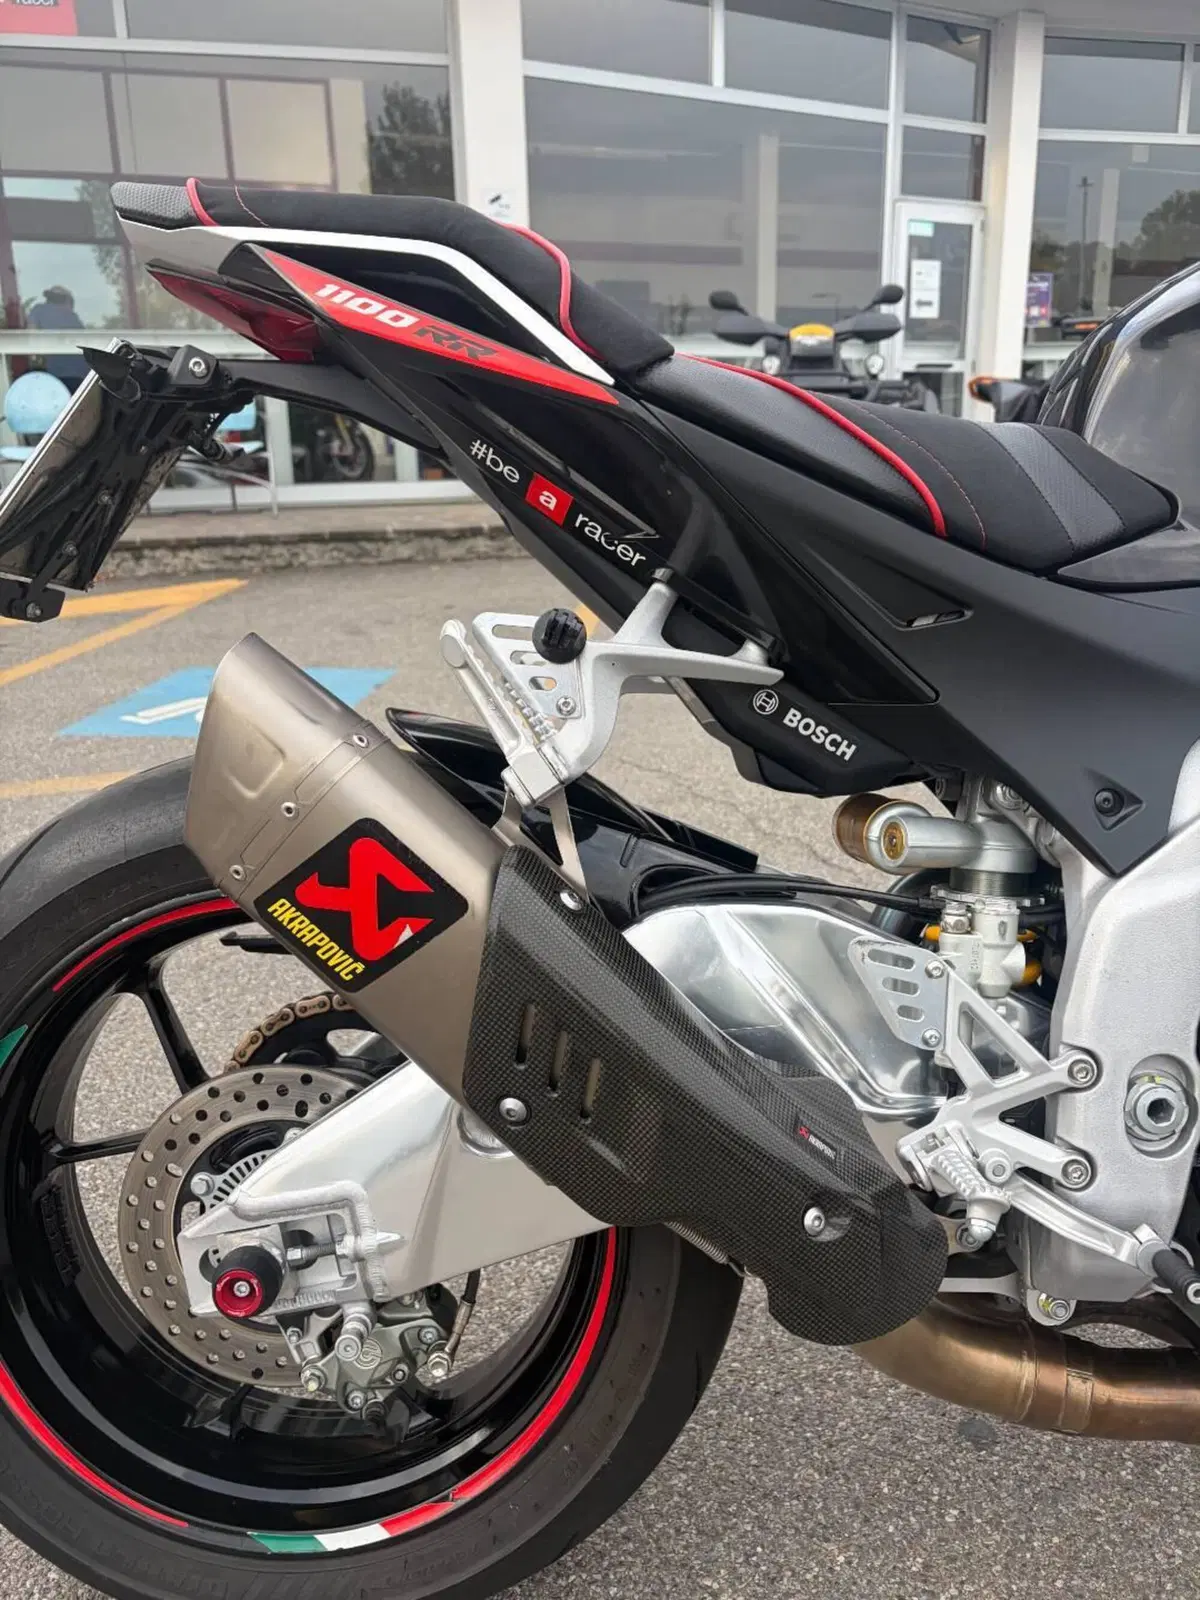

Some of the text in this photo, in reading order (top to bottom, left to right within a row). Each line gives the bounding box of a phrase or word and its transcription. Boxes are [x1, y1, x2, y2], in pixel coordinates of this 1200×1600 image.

[315, 284, 499, 361] 1100 RR
[470, 440, 647, 566] #be a racer
[783, 707, 857, 761] BOSCH
[267, 898, 365, 981] AKRAPOVIČ
